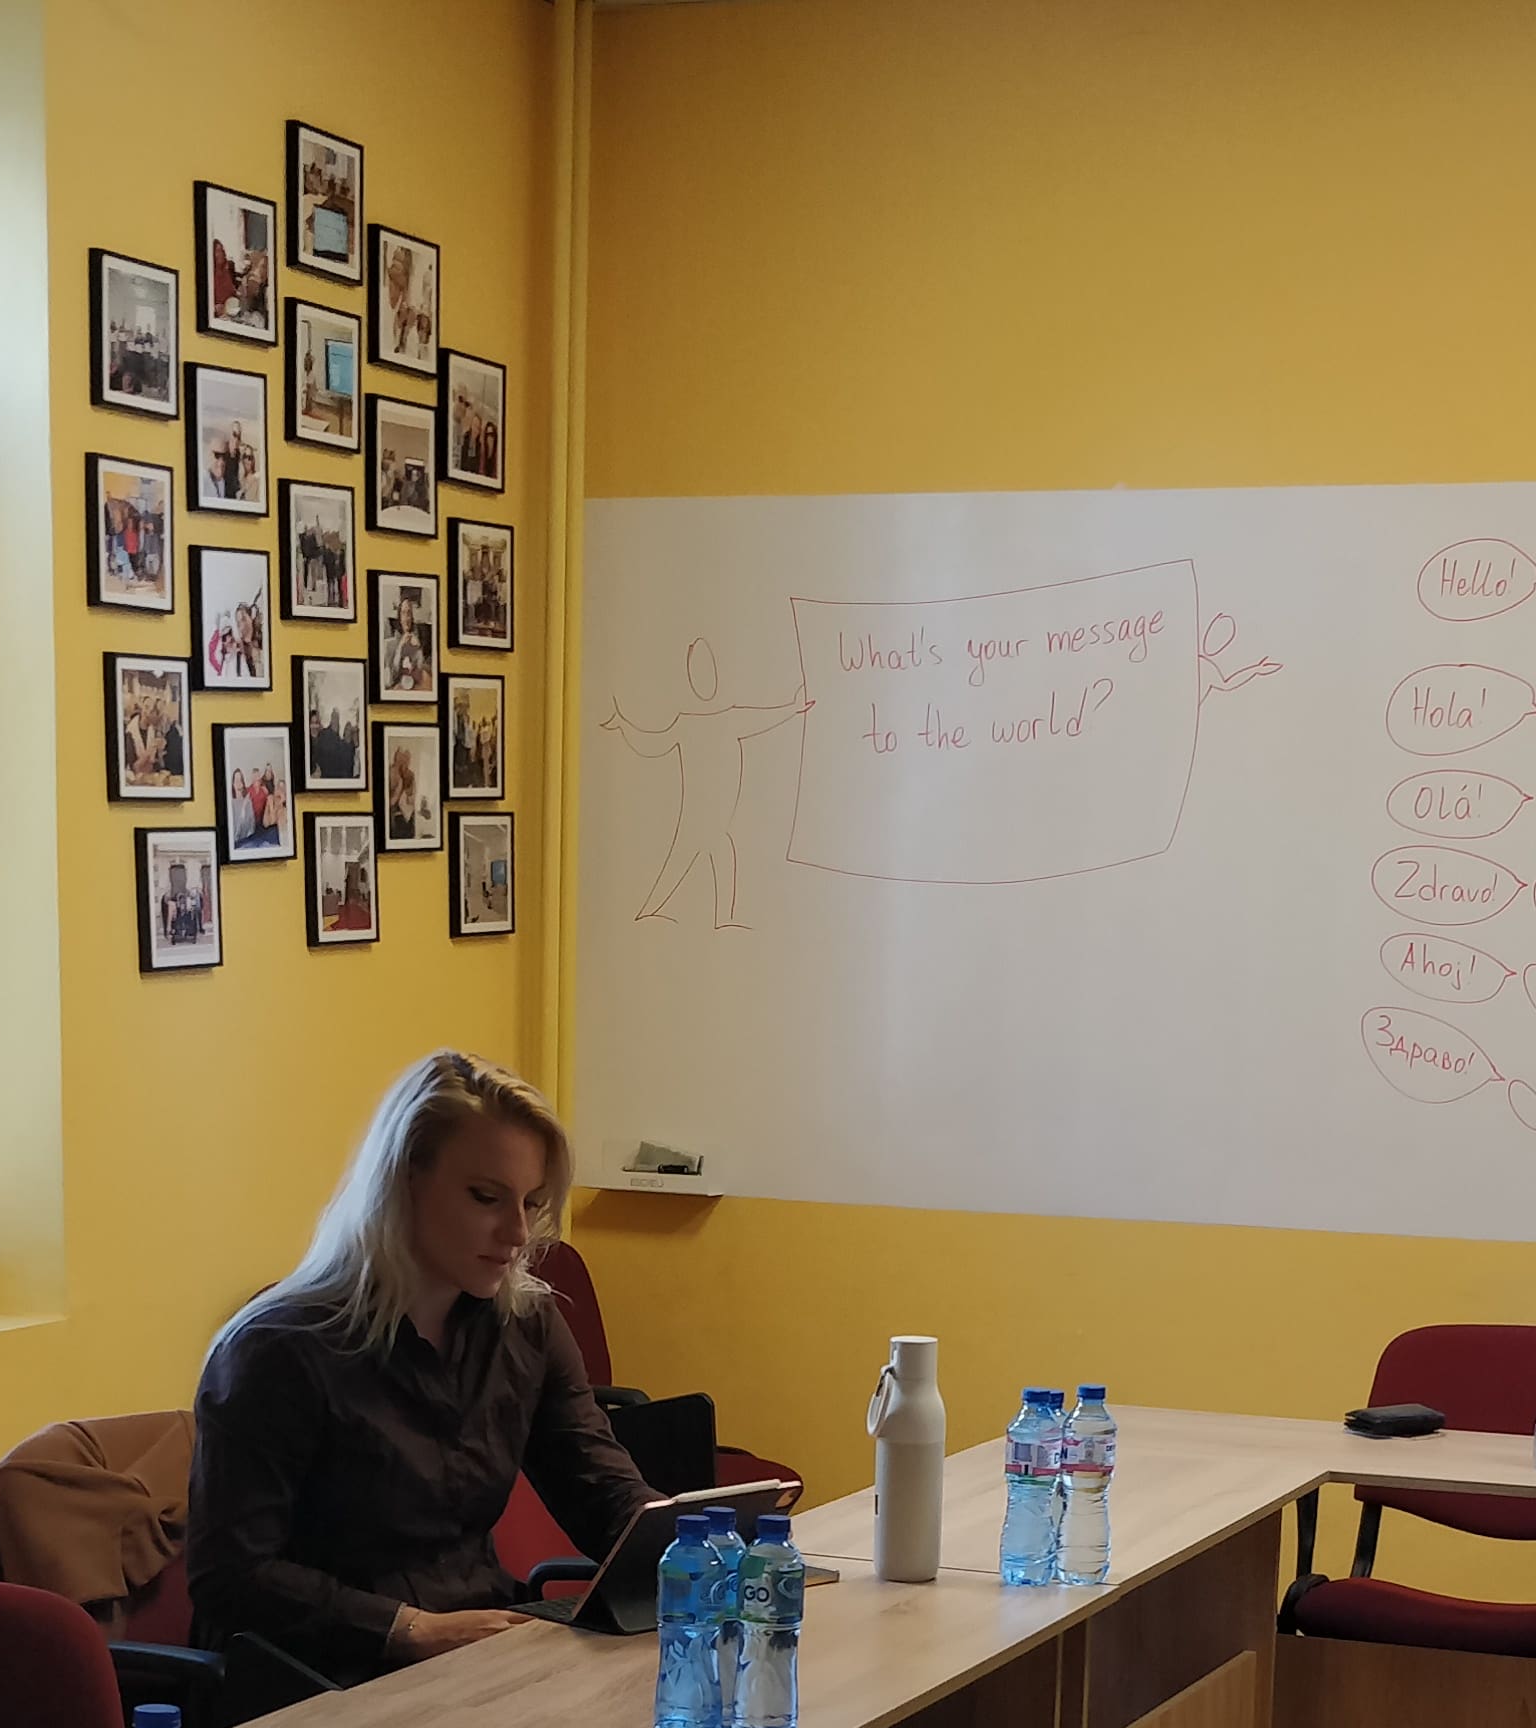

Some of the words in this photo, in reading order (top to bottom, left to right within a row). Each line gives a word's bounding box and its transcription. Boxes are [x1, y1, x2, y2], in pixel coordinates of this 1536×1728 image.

[1440, 557, 1516, 598] Hello!
[838, 625, 943, 672] What's
[967, 637, 1029, 687] your
[1047, 610, 1165, 663] message
[862, 702, 898, 754] to
[917, 702, 970, 749] the
[991, 678, 1114, 744] world?
[1412, 686, 1487, 729] Hola!
[1414, 783, 1482, 820] Olá!
[1394, 860, 1499, 904] Zdravo!
[1400, 942, 1477, 991] Ahoj!
[1375, 1014, 1476, 1075] Здраво!
